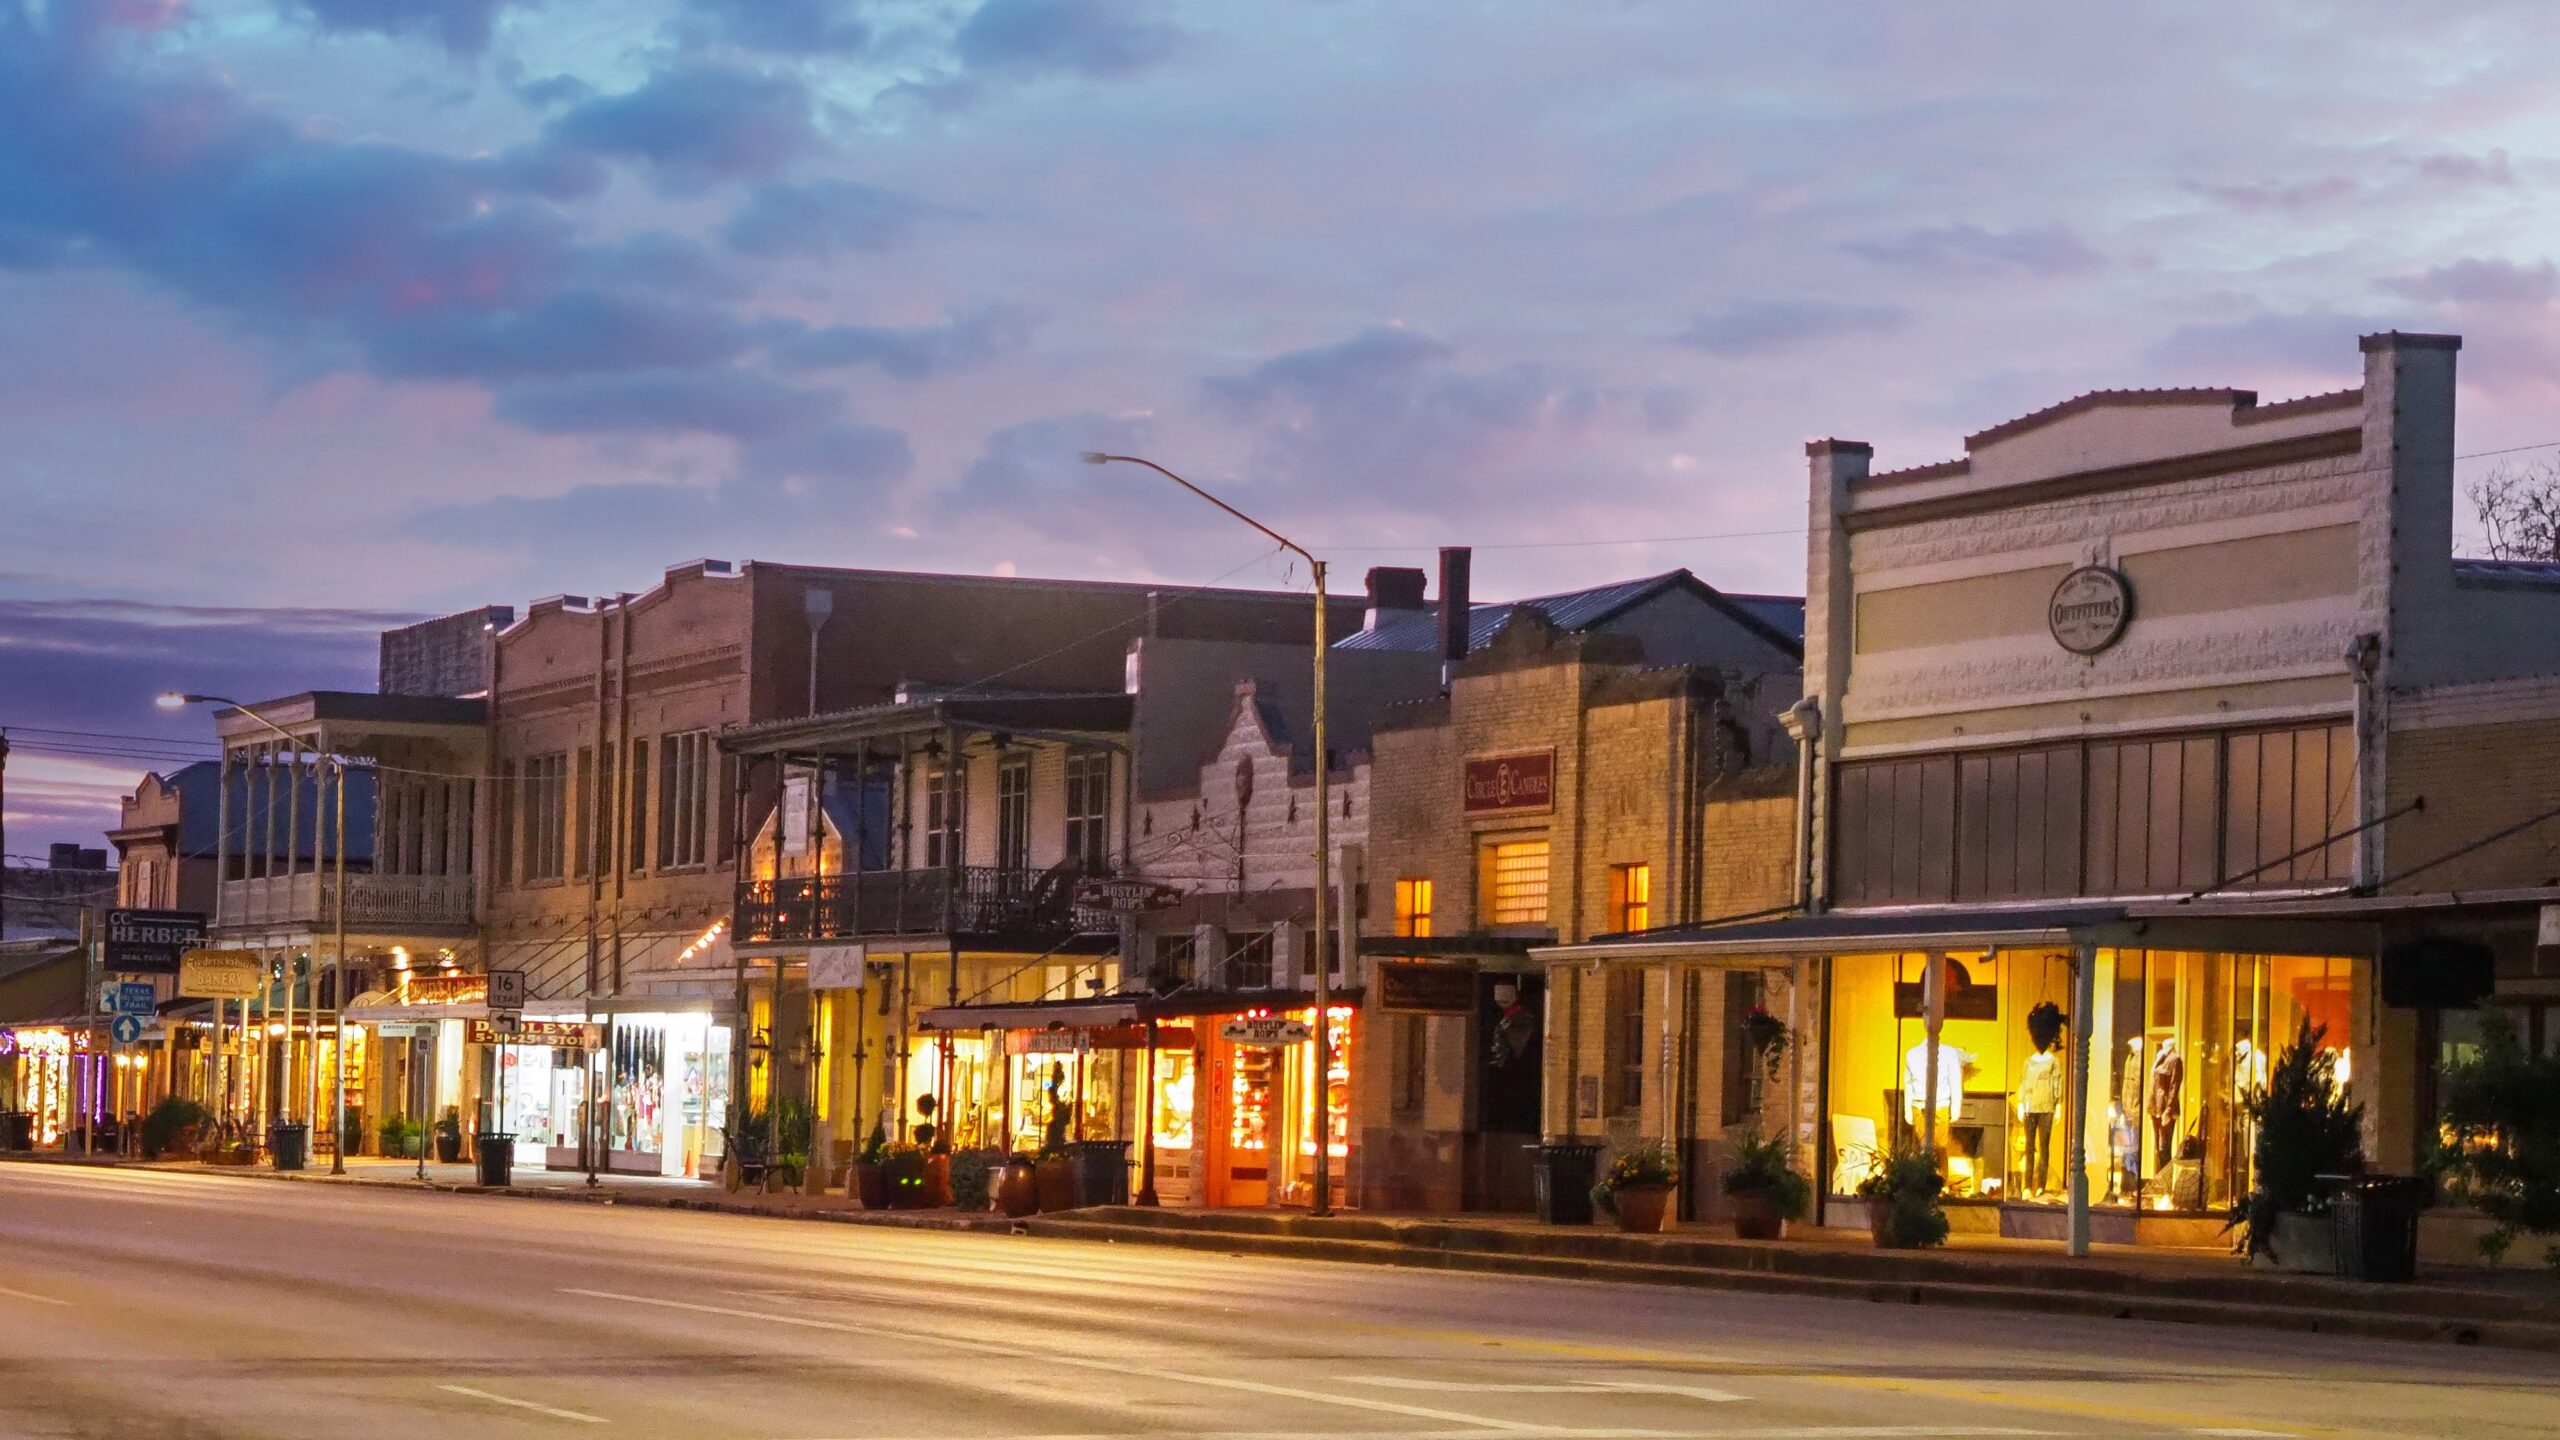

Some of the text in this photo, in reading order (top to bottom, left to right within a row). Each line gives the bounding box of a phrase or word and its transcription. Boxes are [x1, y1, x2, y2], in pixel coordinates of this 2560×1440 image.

[2054, 597, 2119, 625] OUTFITTERS
[1510, 769, 1549, 796] CANDLES
[197, 972, 242, 987] BAKERY
[498, 975, 514, 991] 16
[493, 994, 520, 1004] TEXAS
[547, 1035, 584, 1046] STO
